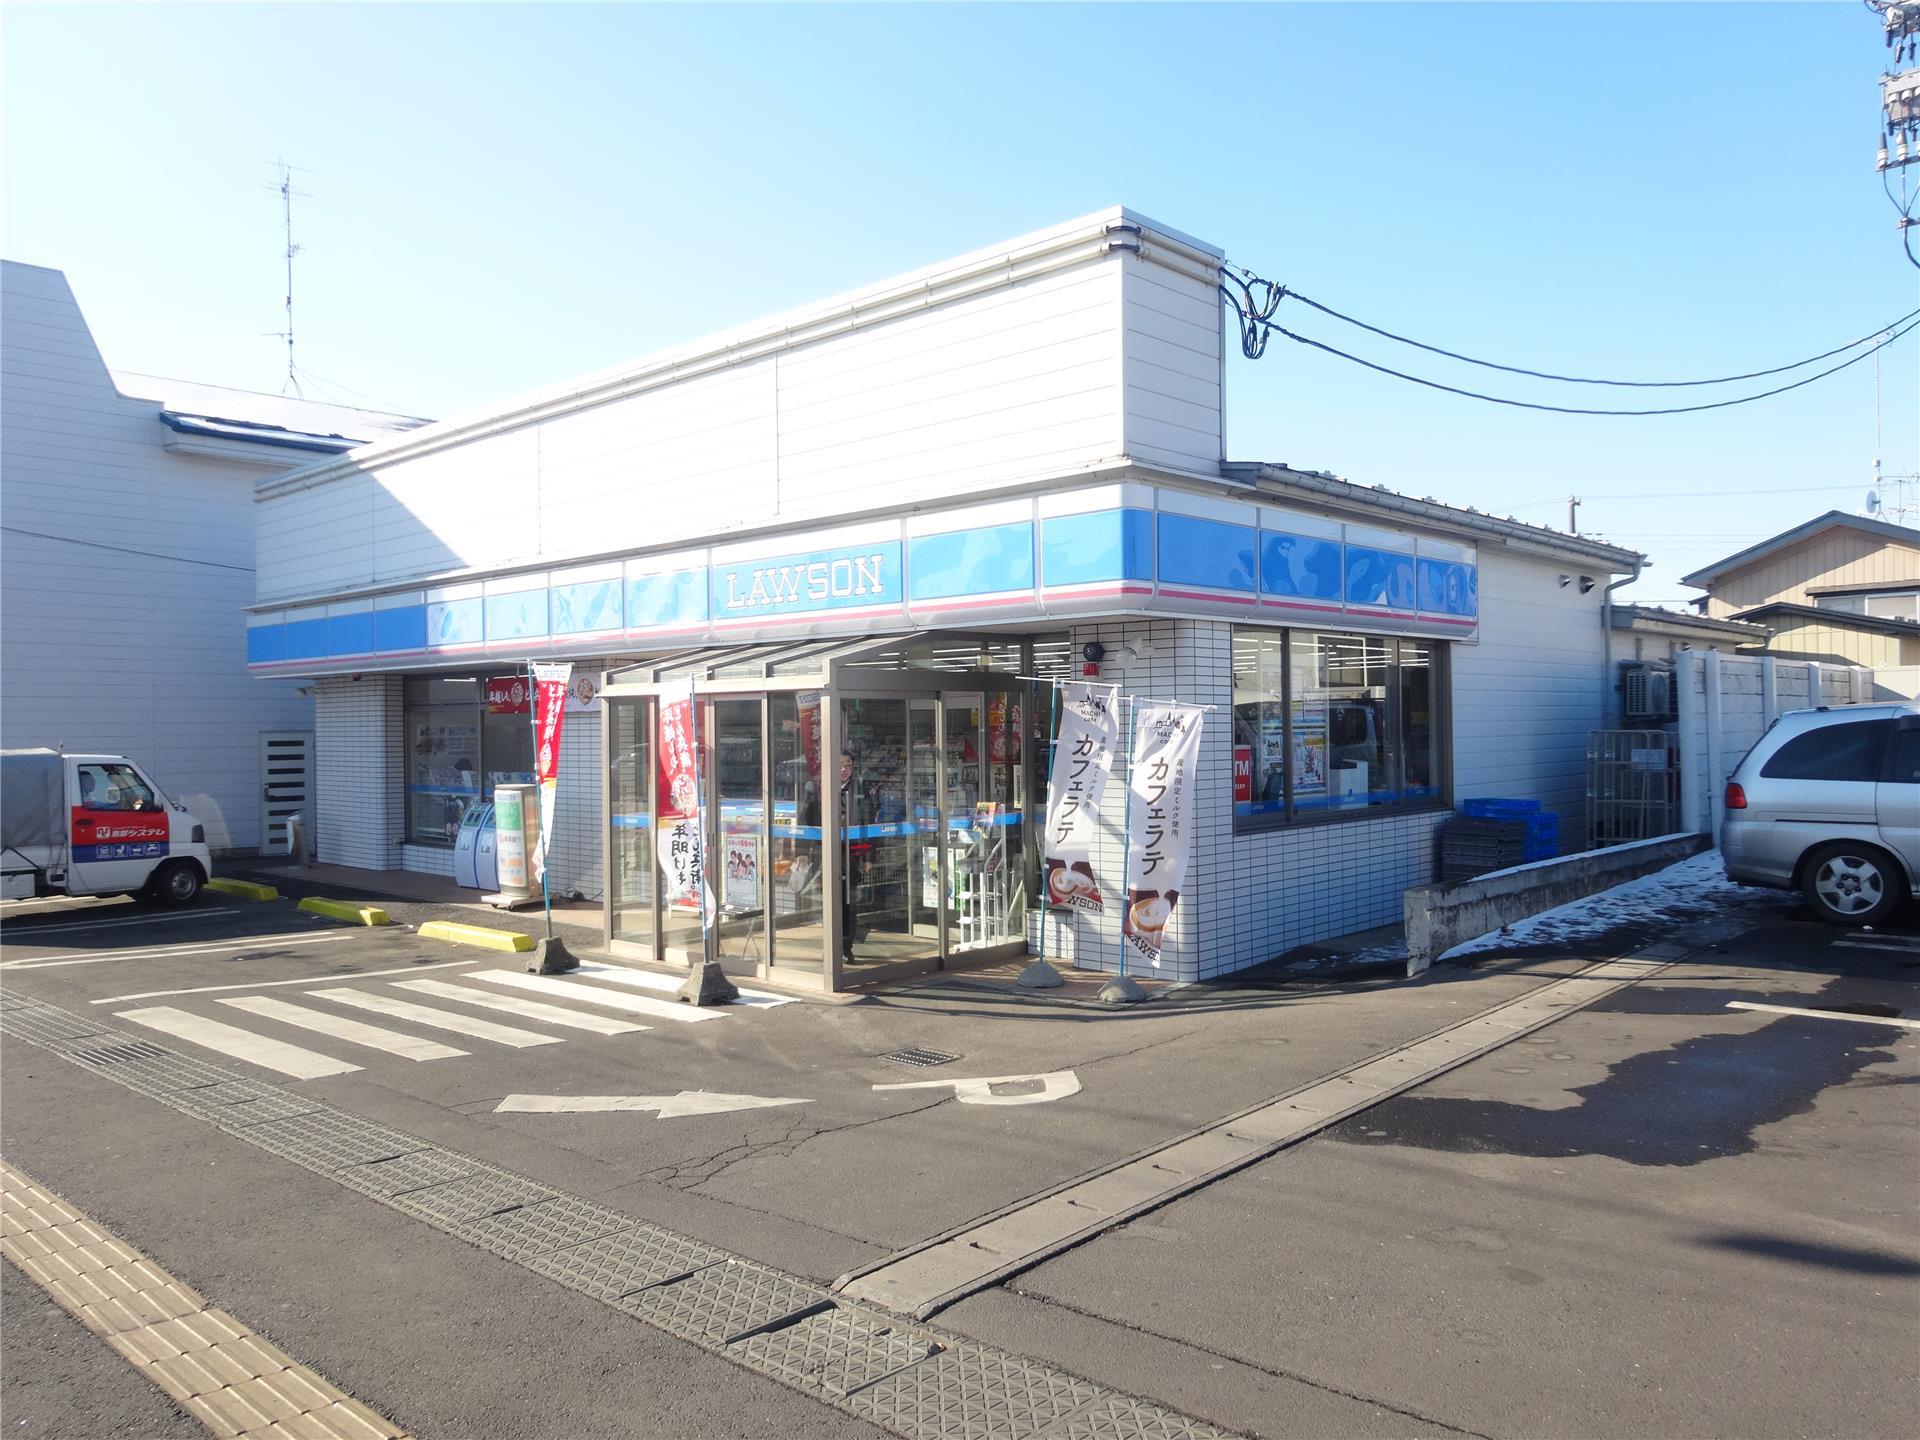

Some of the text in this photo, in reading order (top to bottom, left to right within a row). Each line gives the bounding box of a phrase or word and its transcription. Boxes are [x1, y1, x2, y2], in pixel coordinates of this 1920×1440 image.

[726, 554, 885, 609] LAWSON
[1056, 734, 1093, 844] カフェラテ
[1083, 736, 1107, 809] 産地限定ミルク使用
[1170, 758, 1185, 838] 産地限定ミルク使用
[1142, 757, 1169, 876] カフェラテ
